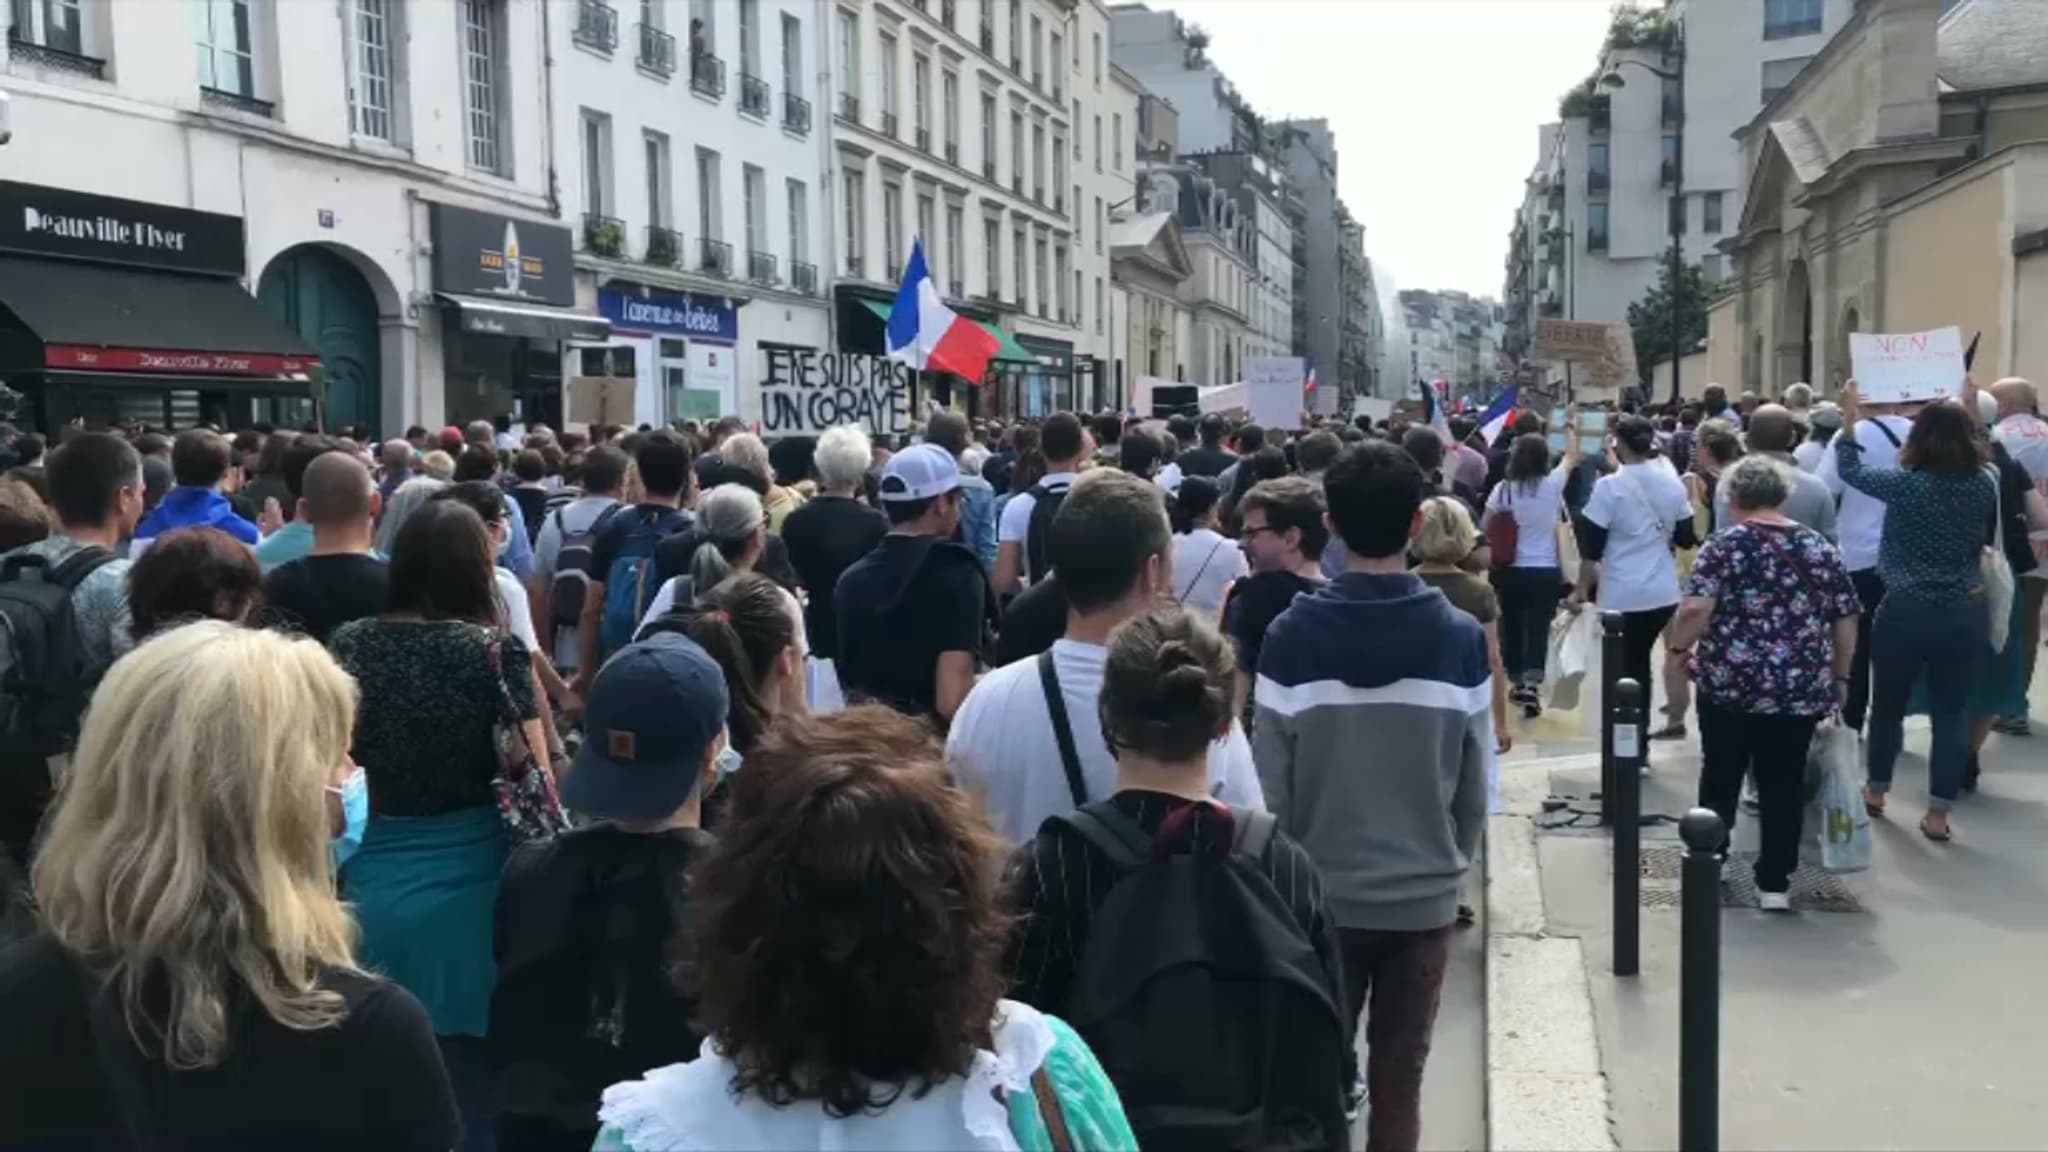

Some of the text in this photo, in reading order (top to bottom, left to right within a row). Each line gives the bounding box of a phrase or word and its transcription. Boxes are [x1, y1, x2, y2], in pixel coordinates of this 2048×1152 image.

[25, 206, 130, 243] Deauville
[1876, 335, 1928, 353] NON
[820, 352, 864, 388] SUIS
[871, 354, 906, 389] PAS
[762, 392, 803, 430] UN
